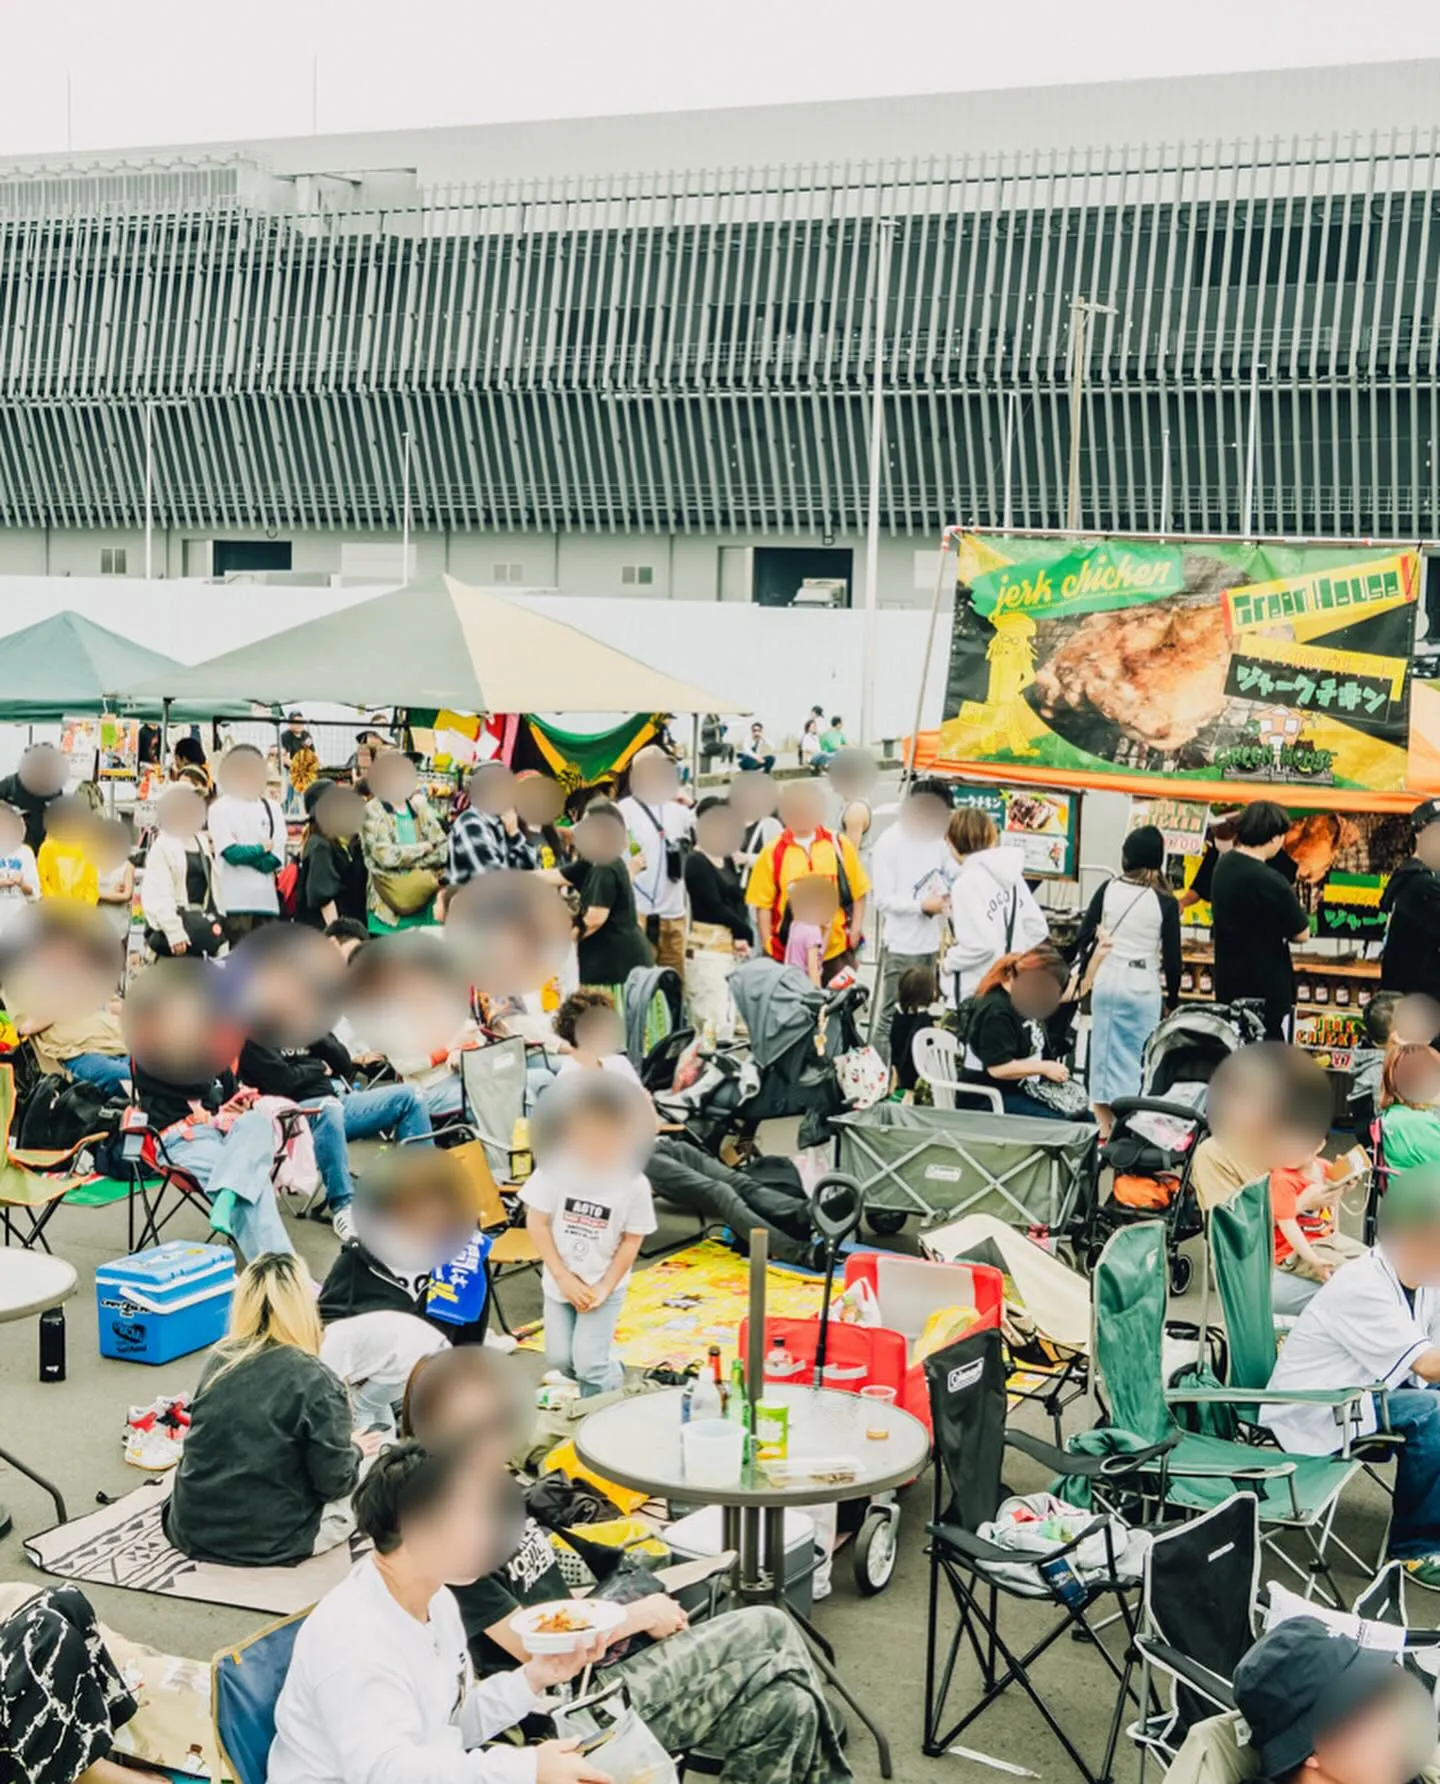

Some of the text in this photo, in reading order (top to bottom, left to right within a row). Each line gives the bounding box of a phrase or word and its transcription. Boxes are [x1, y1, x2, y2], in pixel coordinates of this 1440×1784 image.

[988, 554, 1172, 623] jerk chicken
[1235, 665, 1388, 714] ジャークチキン
[1214, 744, 1338, 770] GREEN HOUSE
